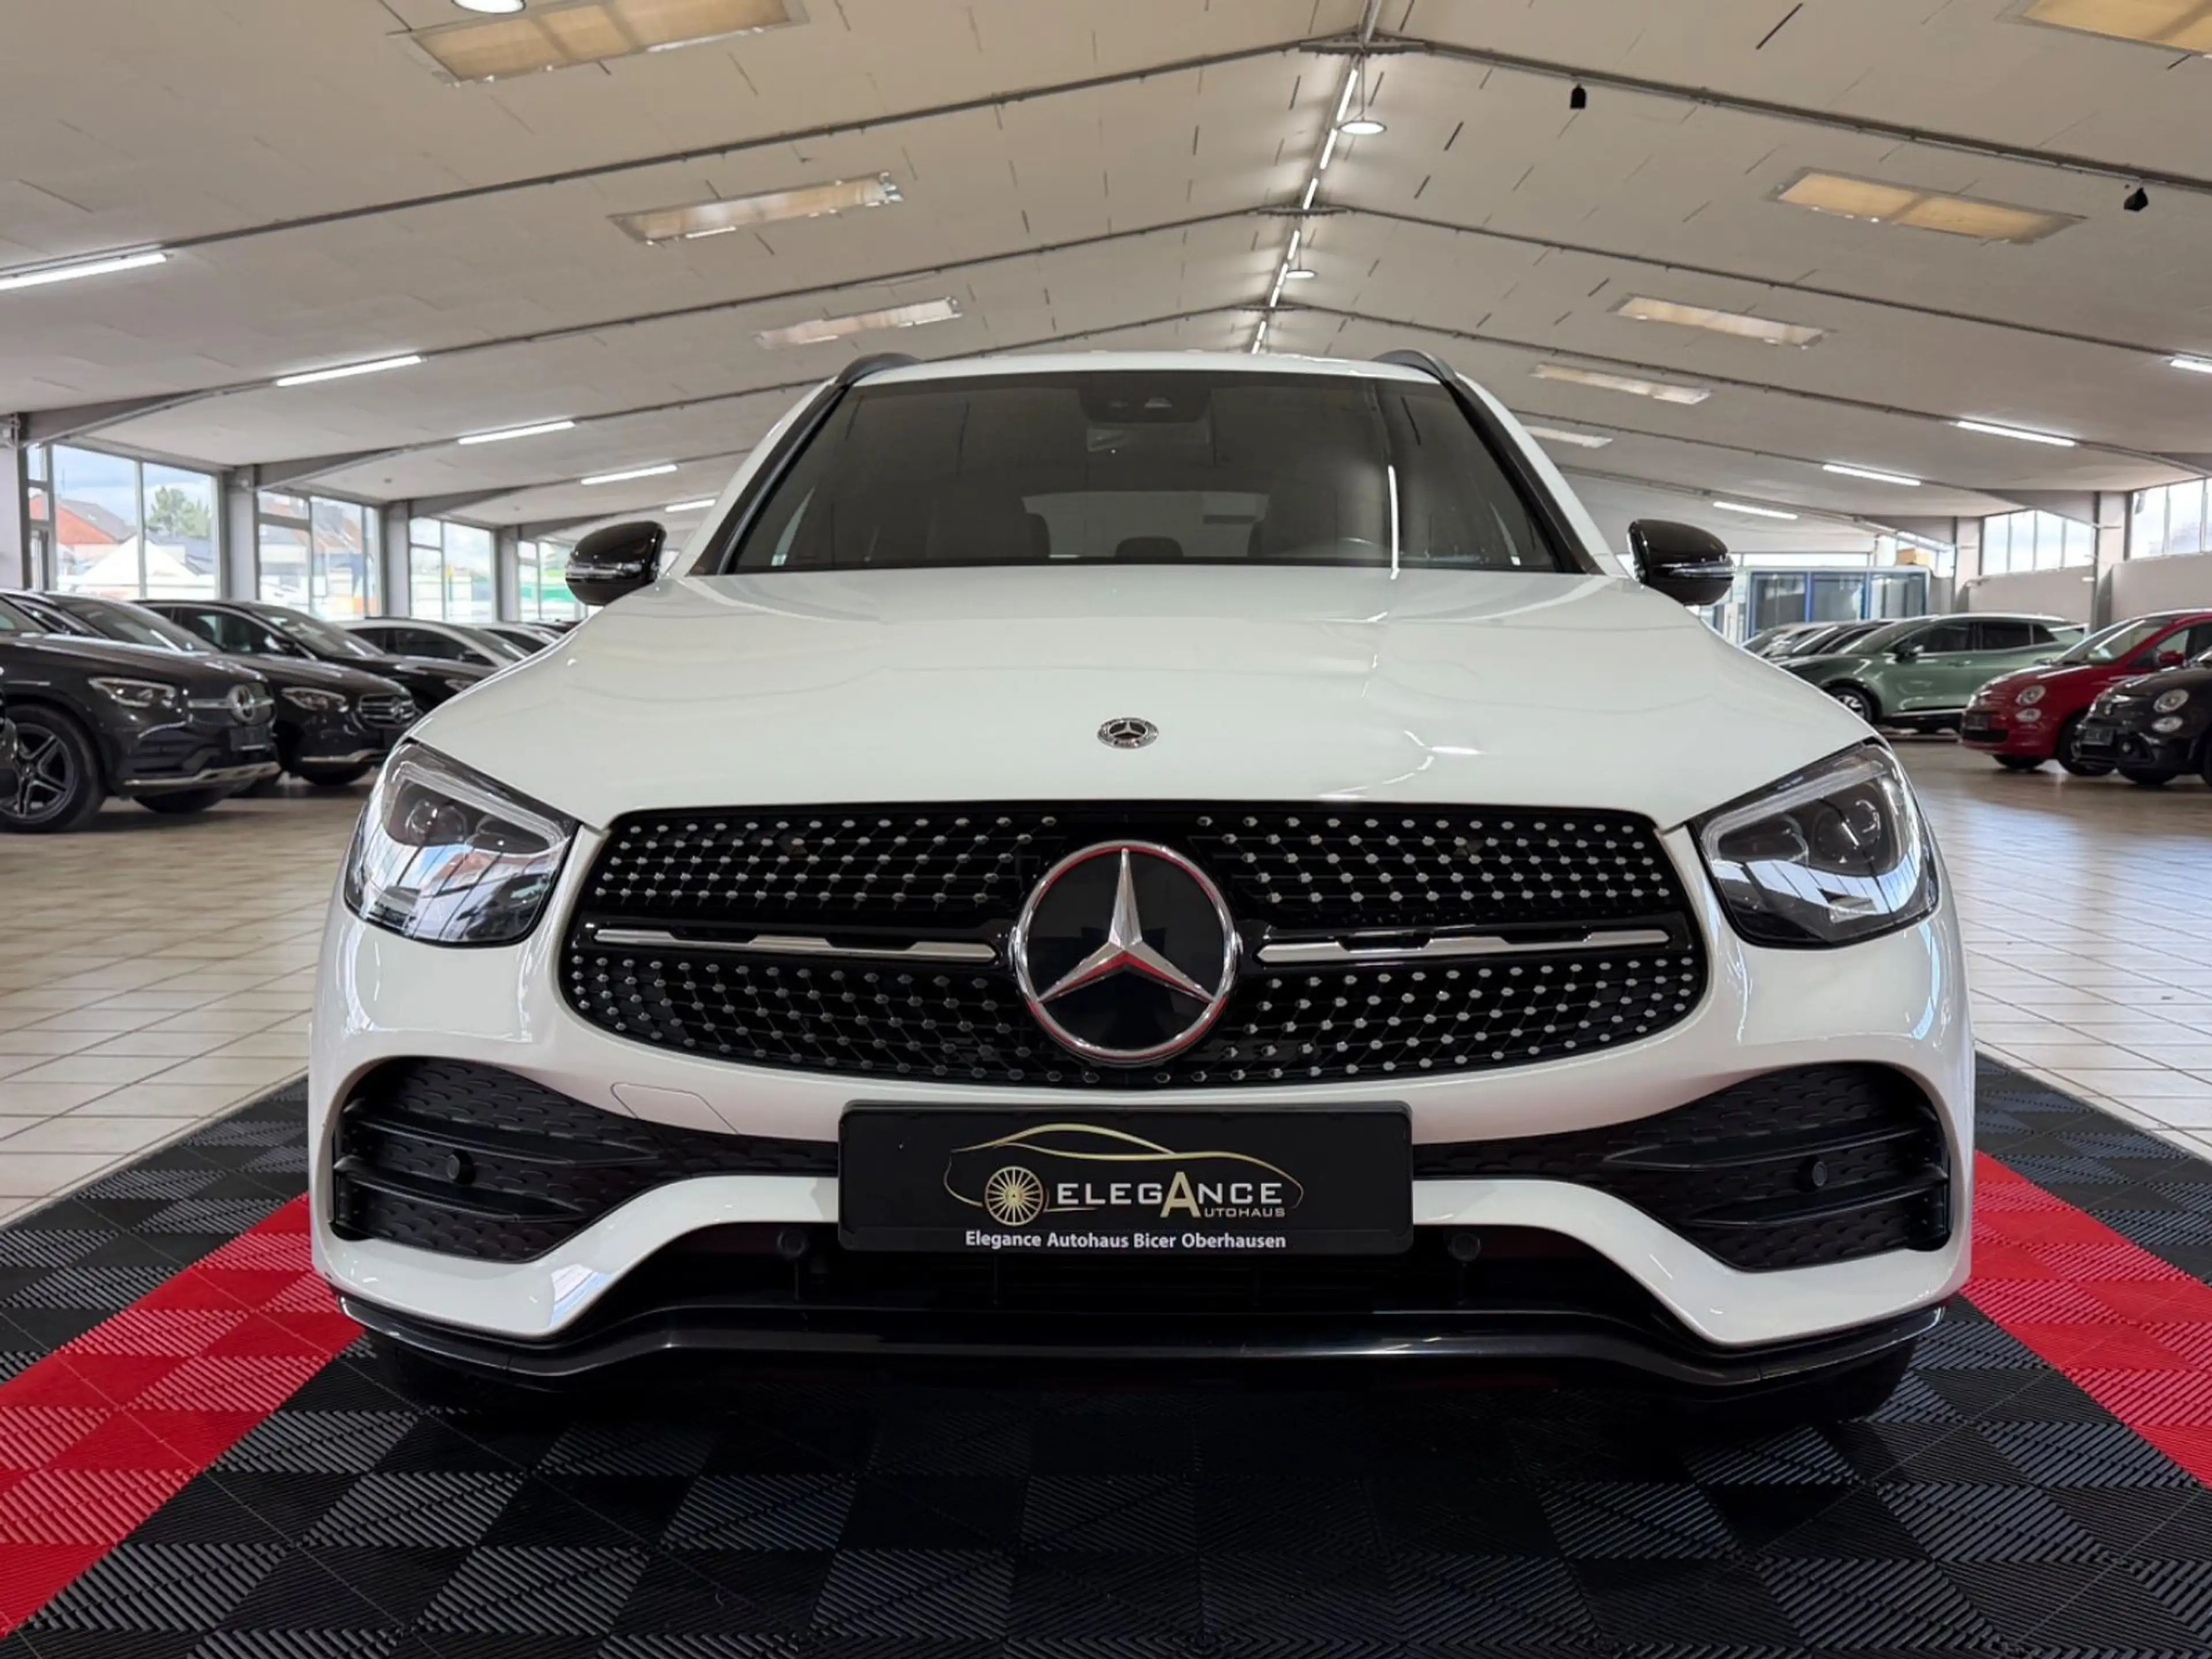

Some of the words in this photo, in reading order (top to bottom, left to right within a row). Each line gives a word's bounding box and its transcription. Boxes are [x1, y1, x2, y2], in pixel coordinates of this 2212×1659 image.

[1057, 1171, 1283, 1218] ELEGANCE
[965, 1230, 1041, 1249] Elegance
[1047, 1232, 1129, 1248] Autohaus
[1134, 1232, 1176, 1248] Bicer
[1181, 1232, 1286, 1248] Oberhausen
